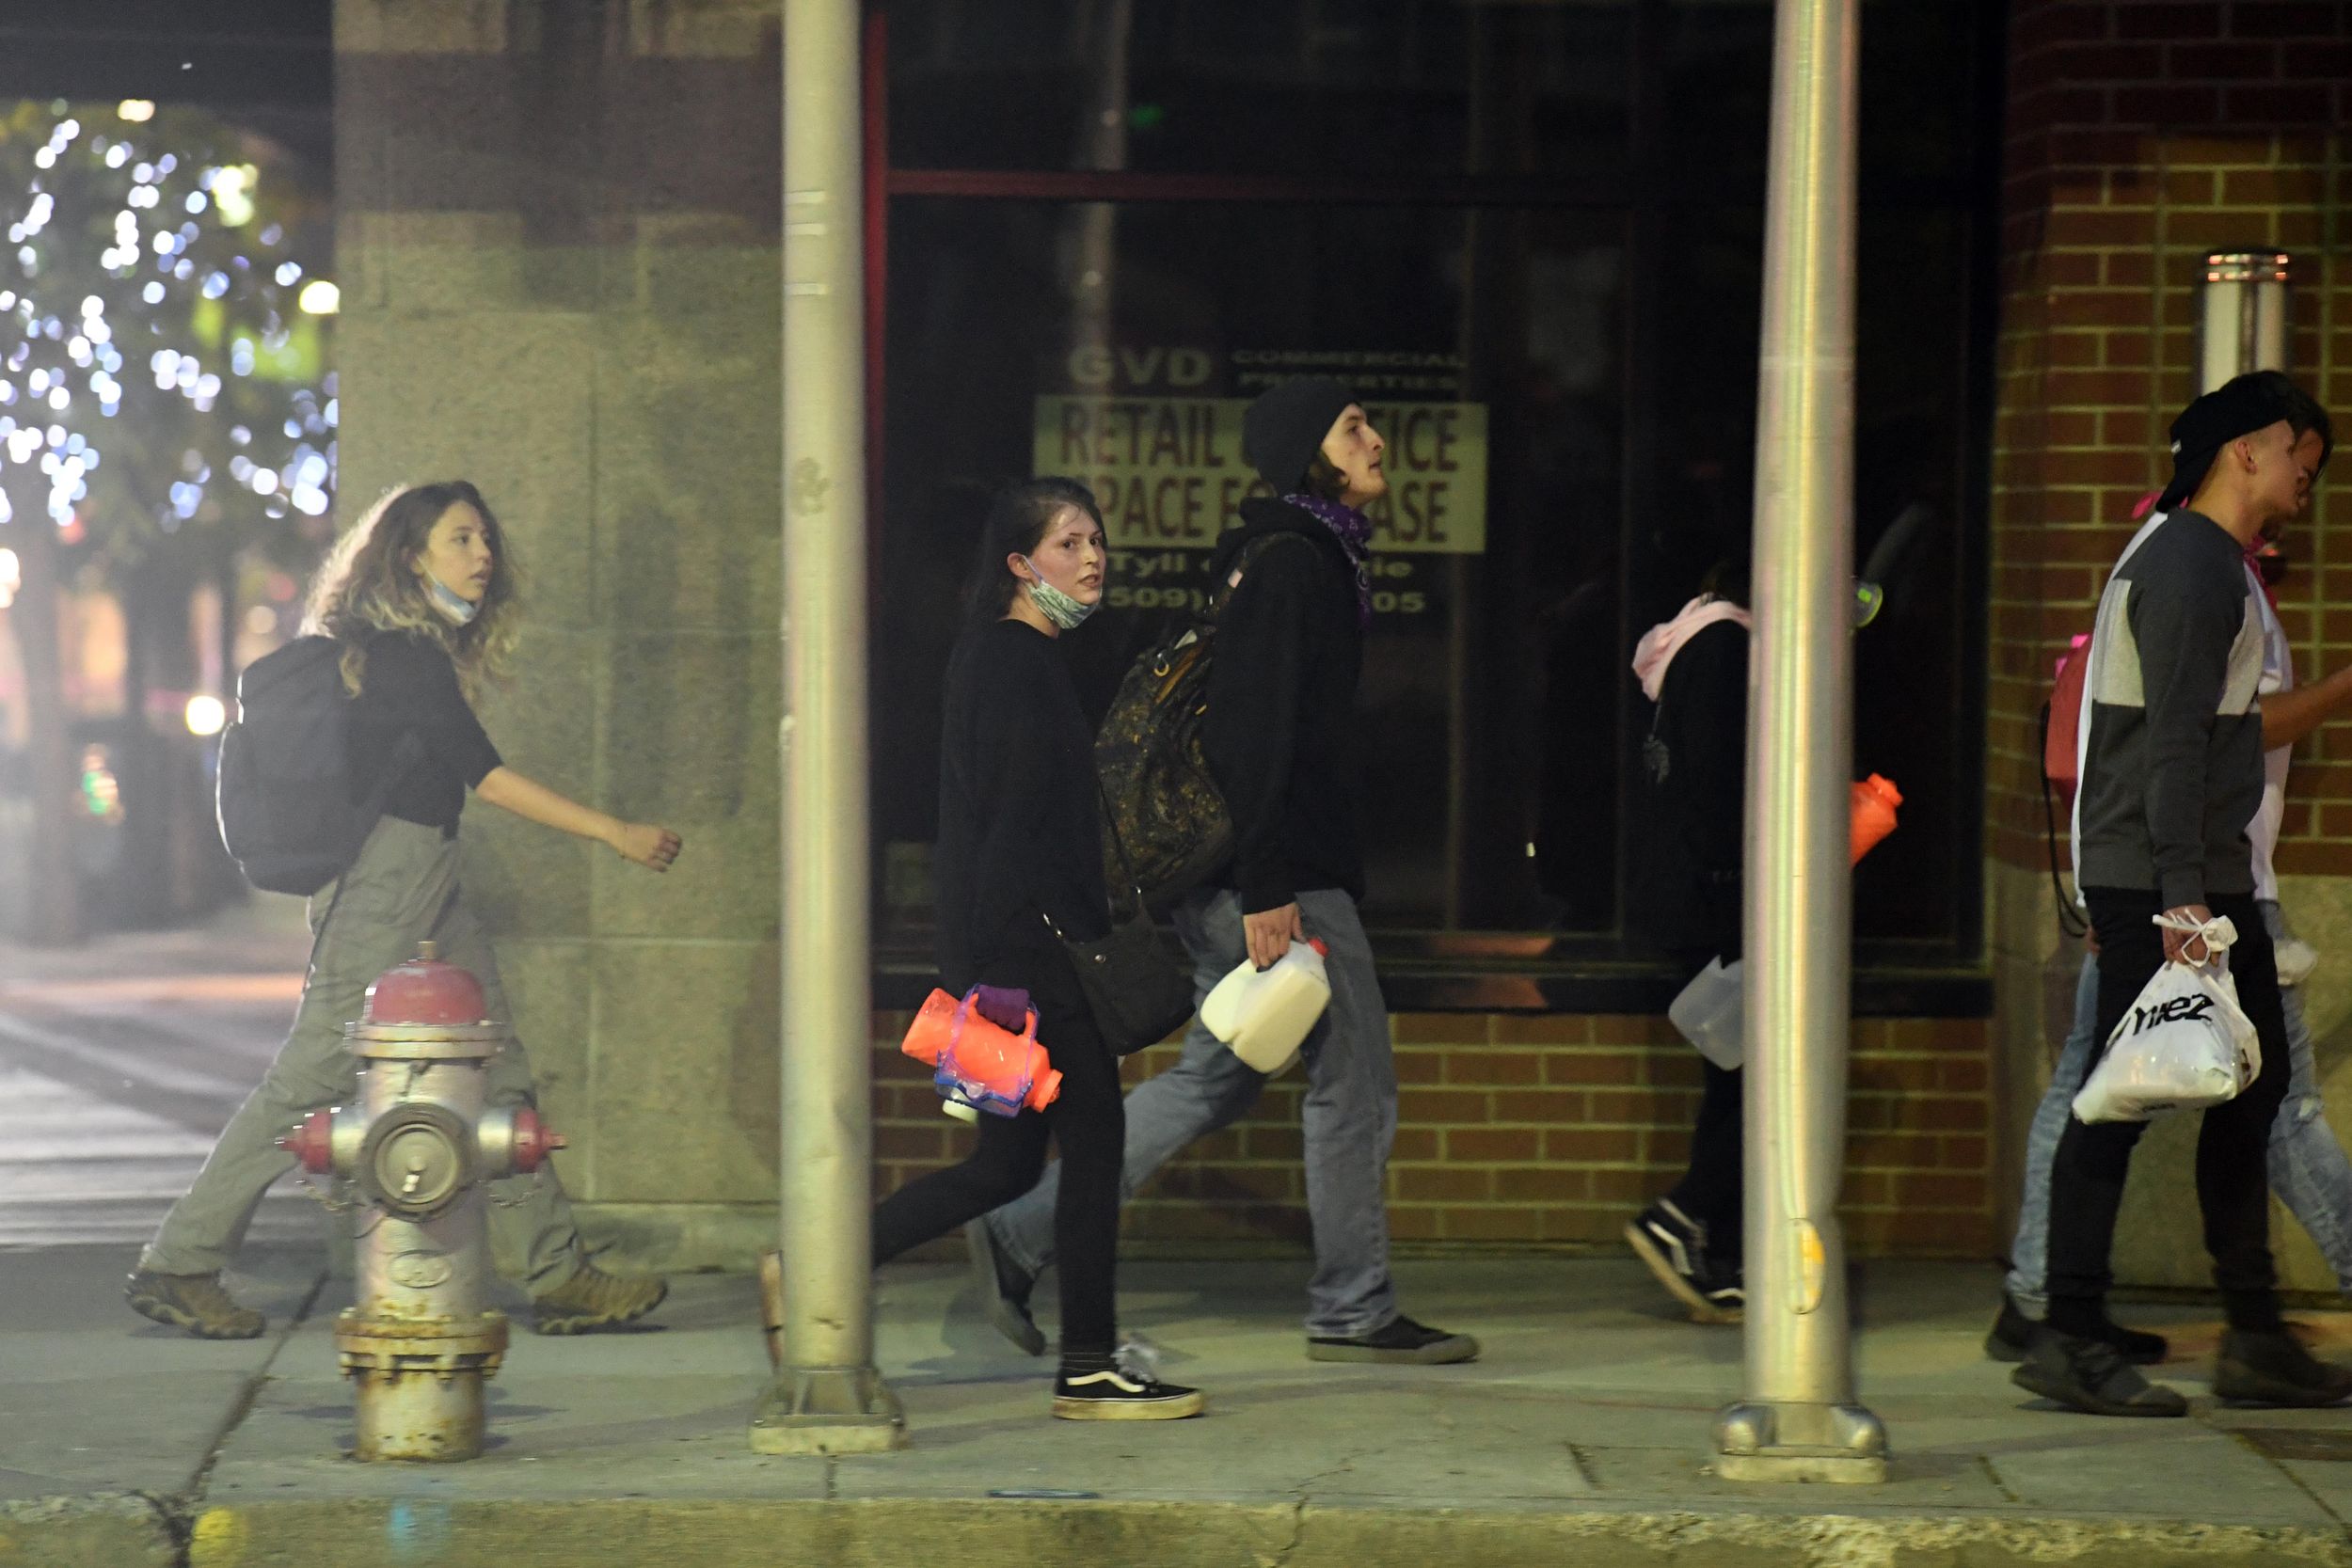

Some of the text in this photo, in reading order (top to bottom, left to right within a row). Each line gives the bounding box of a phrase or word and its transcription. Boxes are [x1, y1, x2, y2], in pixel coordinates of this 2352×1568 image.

[1067, 346, 1211, 387] GVD
[1061, 404, 1224, 467] RETAIL
[1076, 475, 1203, 538] PACE
[1108, 587, 1204, 613] 509)
